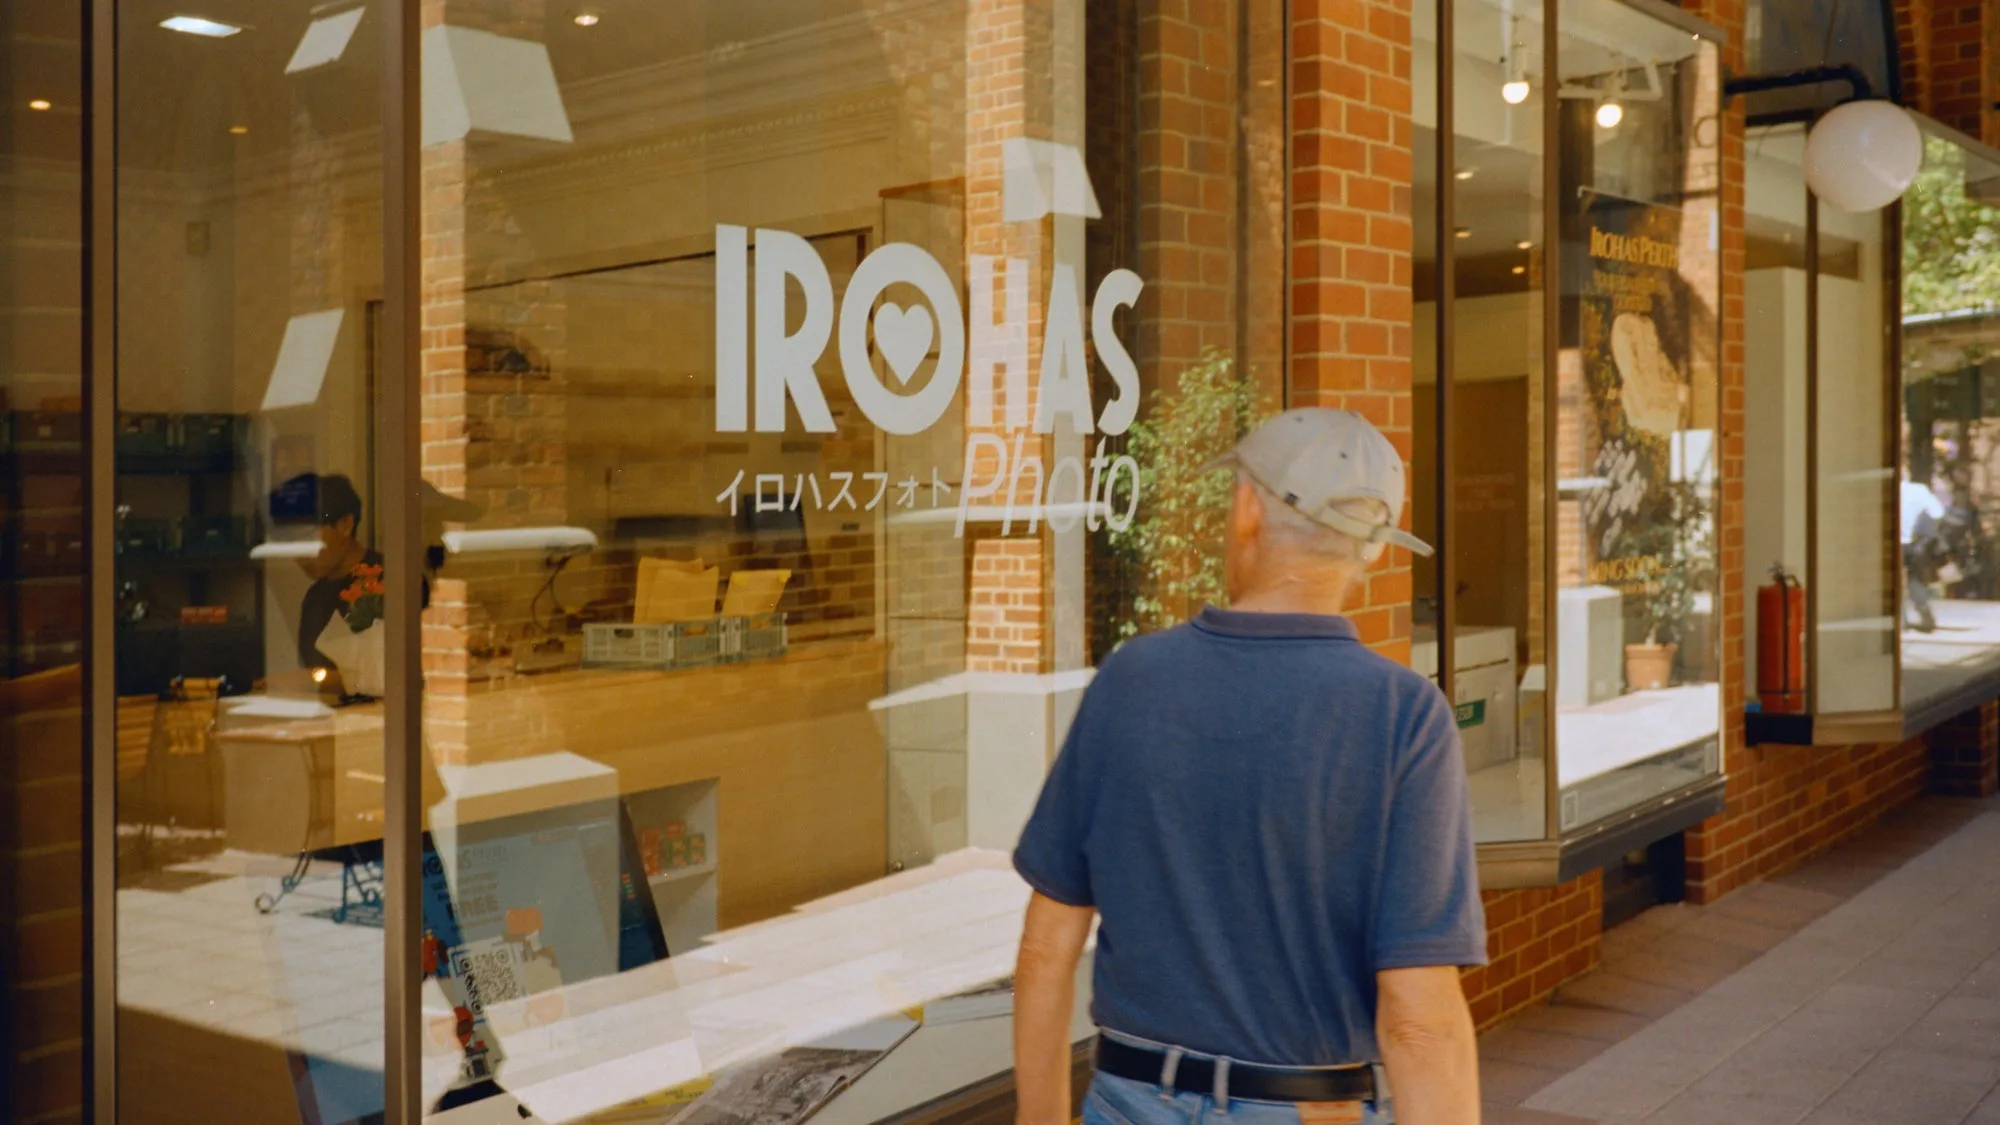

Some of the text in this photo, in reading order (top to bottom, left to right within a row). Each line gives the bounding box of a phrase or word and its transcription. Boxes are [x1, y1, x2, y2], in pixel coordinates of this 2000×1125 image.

[715, 223, 1144, 437] IROHAS
[715, 466, 952, 517] イロハスフォト
[954, 432, 1141, 538] Photo
